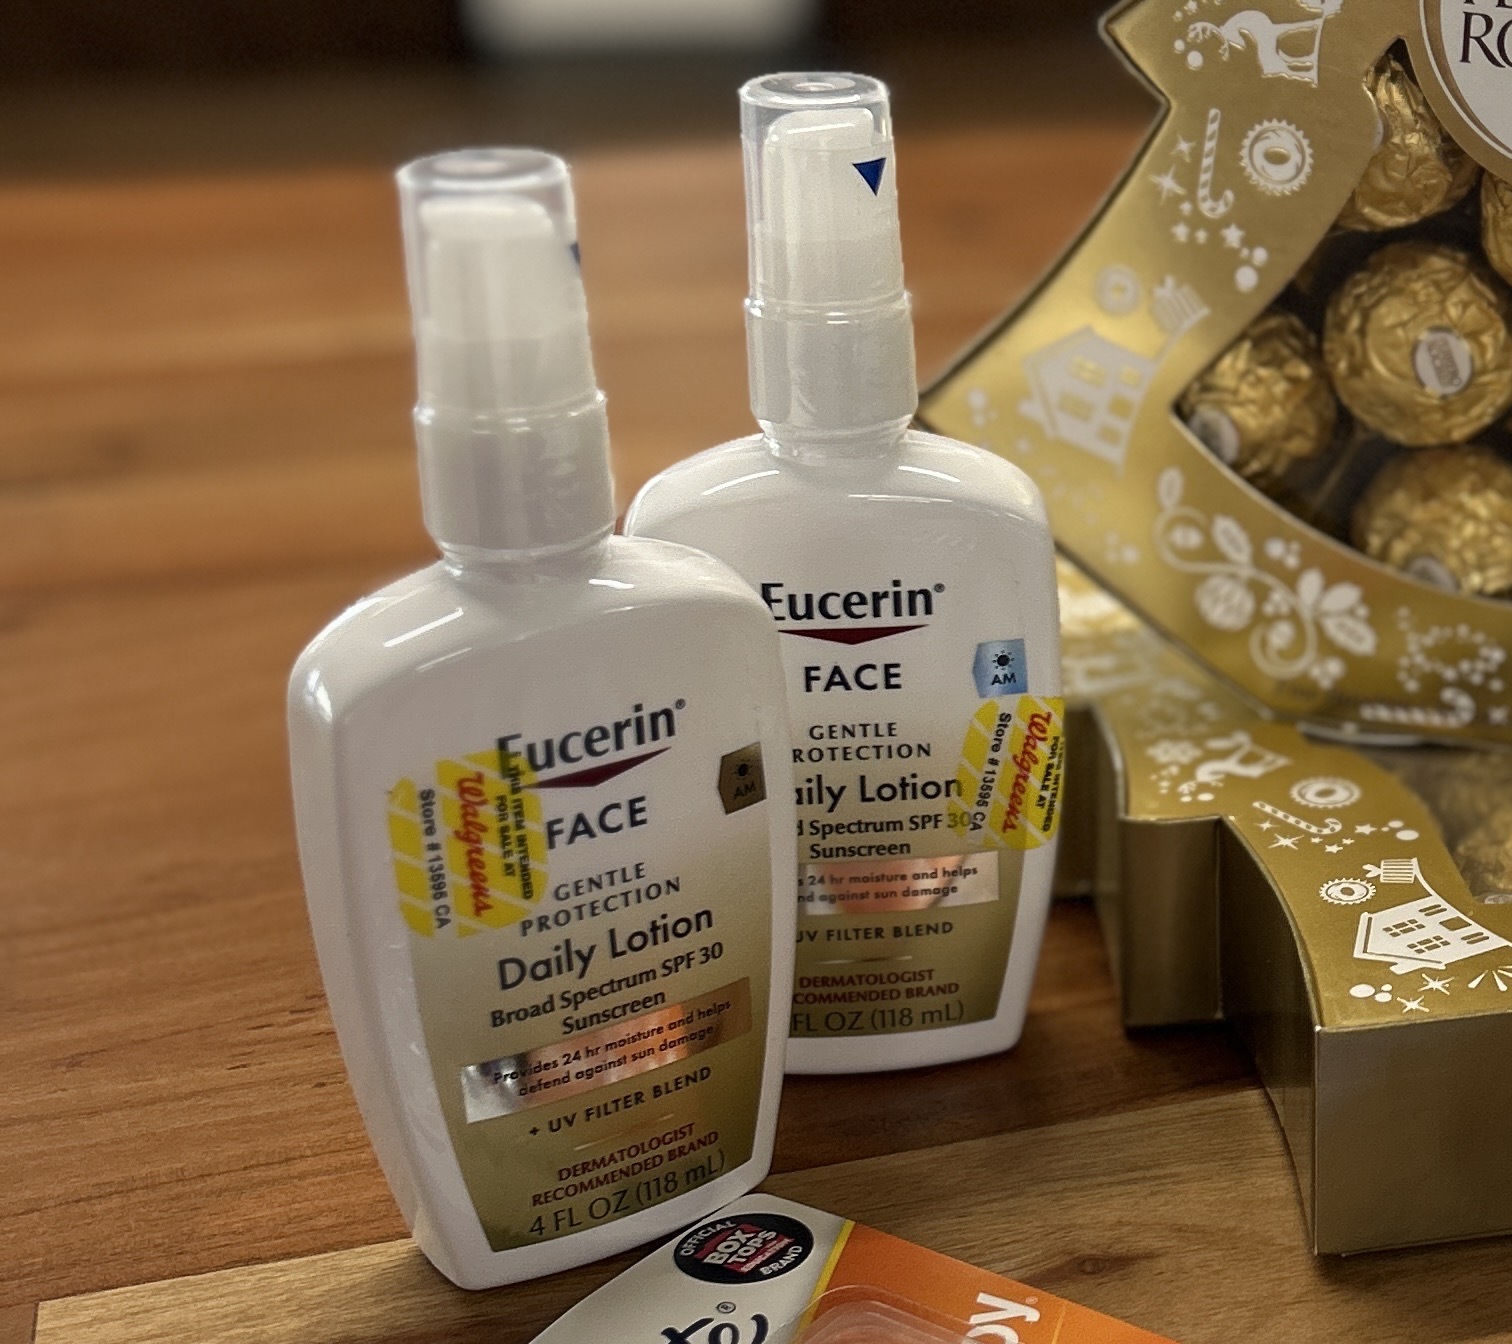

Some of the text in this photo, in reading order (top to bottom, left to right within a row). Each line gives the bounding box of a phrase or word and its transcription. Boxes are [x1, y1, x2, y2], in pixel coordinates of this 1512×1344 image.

[803, 663, 902, 693] FACE
[991, 672, 1017, 686] AM
[809, 722, 898, 741] GENTLE
[990, 712, 1012, 753] Store
[792, 743, 931, 764] ROTECTION
[1002, 712, 1053, 833] Walgreens
[1036, 736, 1060, 809] FOR SALE AT
[733, 781, 756, 800] AM
[795, 773, 963, 813] ily Lotion
[1042, 773, 1061, 832] INTENDED
[512, 797, 525, 830] ITEM
[545, 796, 648, 850] FACE
[809, 815, 904, 840] Spectrum
[908, 814, 943, 831] SPF
[947, 810, 970, 830] 30
[969, 811, 987, 831] CA
[454, 771, 495, 917] Walgreens
[496, 794, 516, 877] FOR SALE AT
[809, 842, 912, 860] Sunscreen
[419, 788, 436, 836] Store
[435, 904, 452, 929] CA
[516, 833, 534, 900] INTENDED
[808, 874, 826, 886] 24
[829, 873, 844, 885] hr
[848, 870, 908, 885] moisture
[912, 868, 938, 881] and
[942, 865, 979, 880] helps
[554, 862, 646, 902] GENTLE
[818, 889, 870, 904] against
[874, 888, 898, 900] sun
[902, 884, 959, 899] damage
[520, 876, 681, 937] PROTECTION
[498, 908, 715, 991] Daily Lotion
[826, 926, 884, 942] FILTER
[893, 922, 954, 938] BLEND
[490, 942, 723, 1029] Broad Spectrum SPF 30
[792, 982, 960, 1006] COMMENDED BRAND
[799, 968, 936, 989] DERMATOLOGIST
[562, 991, 667, 1035] Sunscreen
[792, 999, 965, 1033] FL OZ (118 mL)
[493, 999, 732, 1086] Provides 24 hr moisture and helps
[518, 1023, 715, 1097] defend against sun damage
[547, 1115, 577, 1134] UV
[585, 1091, 645, 1123] FILTER
[652, 1065, 713, 1100] BLEND
[531, 1130, 719, 1208] RECOMMENDED BRAND
[558, 1122, 695, 1182] DERMATOLOGIST
[528, 1148, 726, 1237] 4 FL OZ (118 mL)
[680, 1220, 737, 1256] OFFICIAL
[703, 1229, 756, 1265] BOX
[726, 1229, 777, 1264] TOPS
[759, 1245, 803, 1276] BRAND
